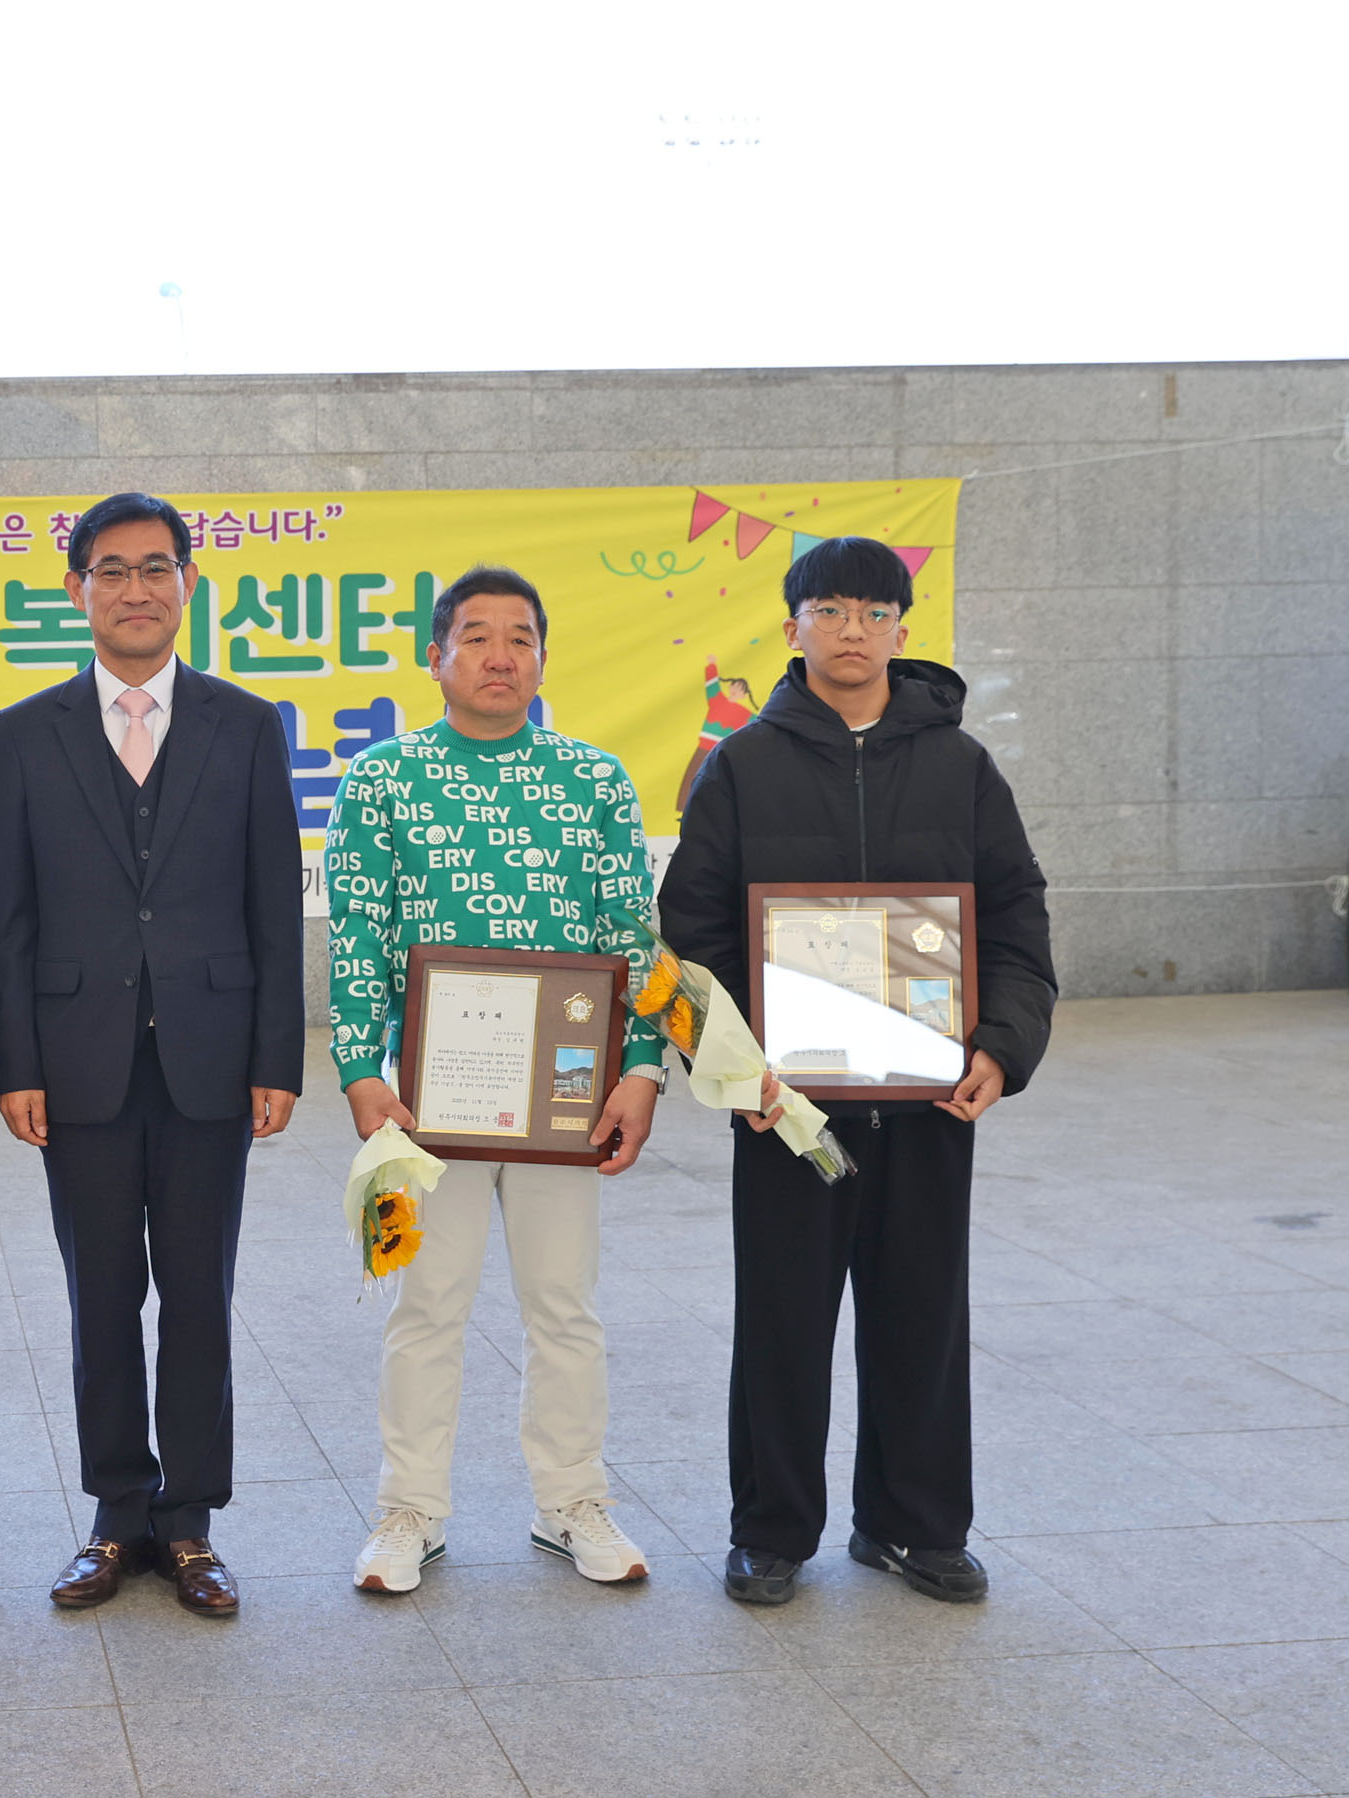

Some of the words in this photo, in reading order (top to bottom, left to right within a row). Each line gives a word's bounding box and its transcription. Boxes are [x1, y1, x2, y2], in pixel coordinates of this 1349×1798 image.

[400, 745, 449, 760] ERY
[556, 748, 601, 761] DIS
[425, 763, 469, 780] DIS
[499, 766, 546, 782] ERY
[574, 762, 615, 780] CO
[442, 783, 499, 802] COV
[523, 784, 566, 801] DIS
[394, 800, 434, 822] DIS
[465, 804, 511, 823] ERY
[540, 803, 594, 823] COV
[407, 825, 465, 845] COV
[488, 826, 532, 846] DIS
[328, 852, 362, 872] DIS
[428, 848, 476, 869] ERY
[504, 847, 561, 868] COV
[334, 875, 389, 898] COV
[452, 872, 496, 892] DIS
[526, 872, 569, 894] ERY
[601, 876, 643, 900] ERY
[348, 898, 392, 923] ERY
[401, 898, 439, 920] ERY
[466, 893, 527, 915] COV
[549, 897, 581, 920] DIS
[419, 920, 457, 943] DIS
[488, 919, 539, 939] ERY
[334, 958, 376, 979] DIS
[348, 980, 388, 999] CO
[336, 1044, 380, 1064] ERY
